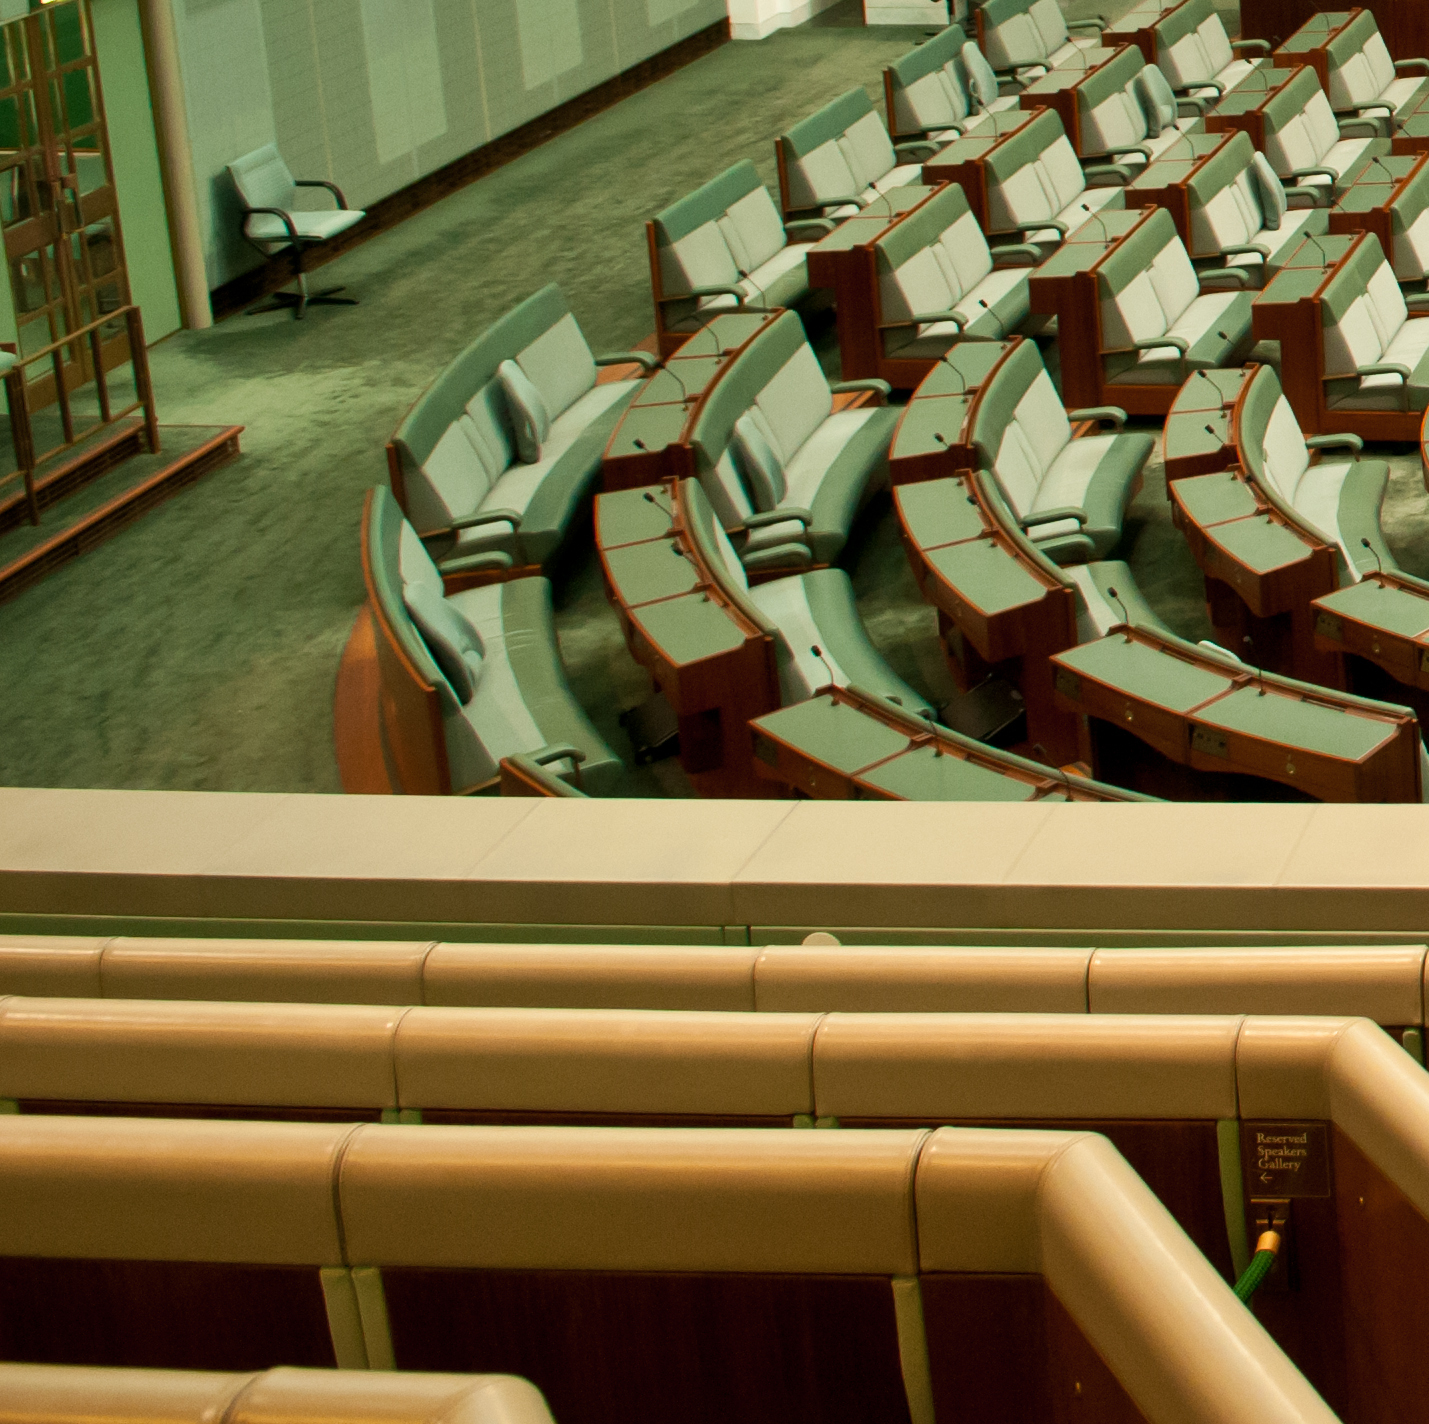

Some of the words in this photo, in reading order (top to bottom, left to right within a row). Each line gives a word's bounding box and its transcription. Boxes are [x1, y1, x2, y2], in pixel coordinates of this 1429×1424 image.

[1256, 1132, 1308, 1144] Reserved
[1257, 1145, 1307, 1161] Speakers
[1257, 1157, 1302, 1172] Gallery
